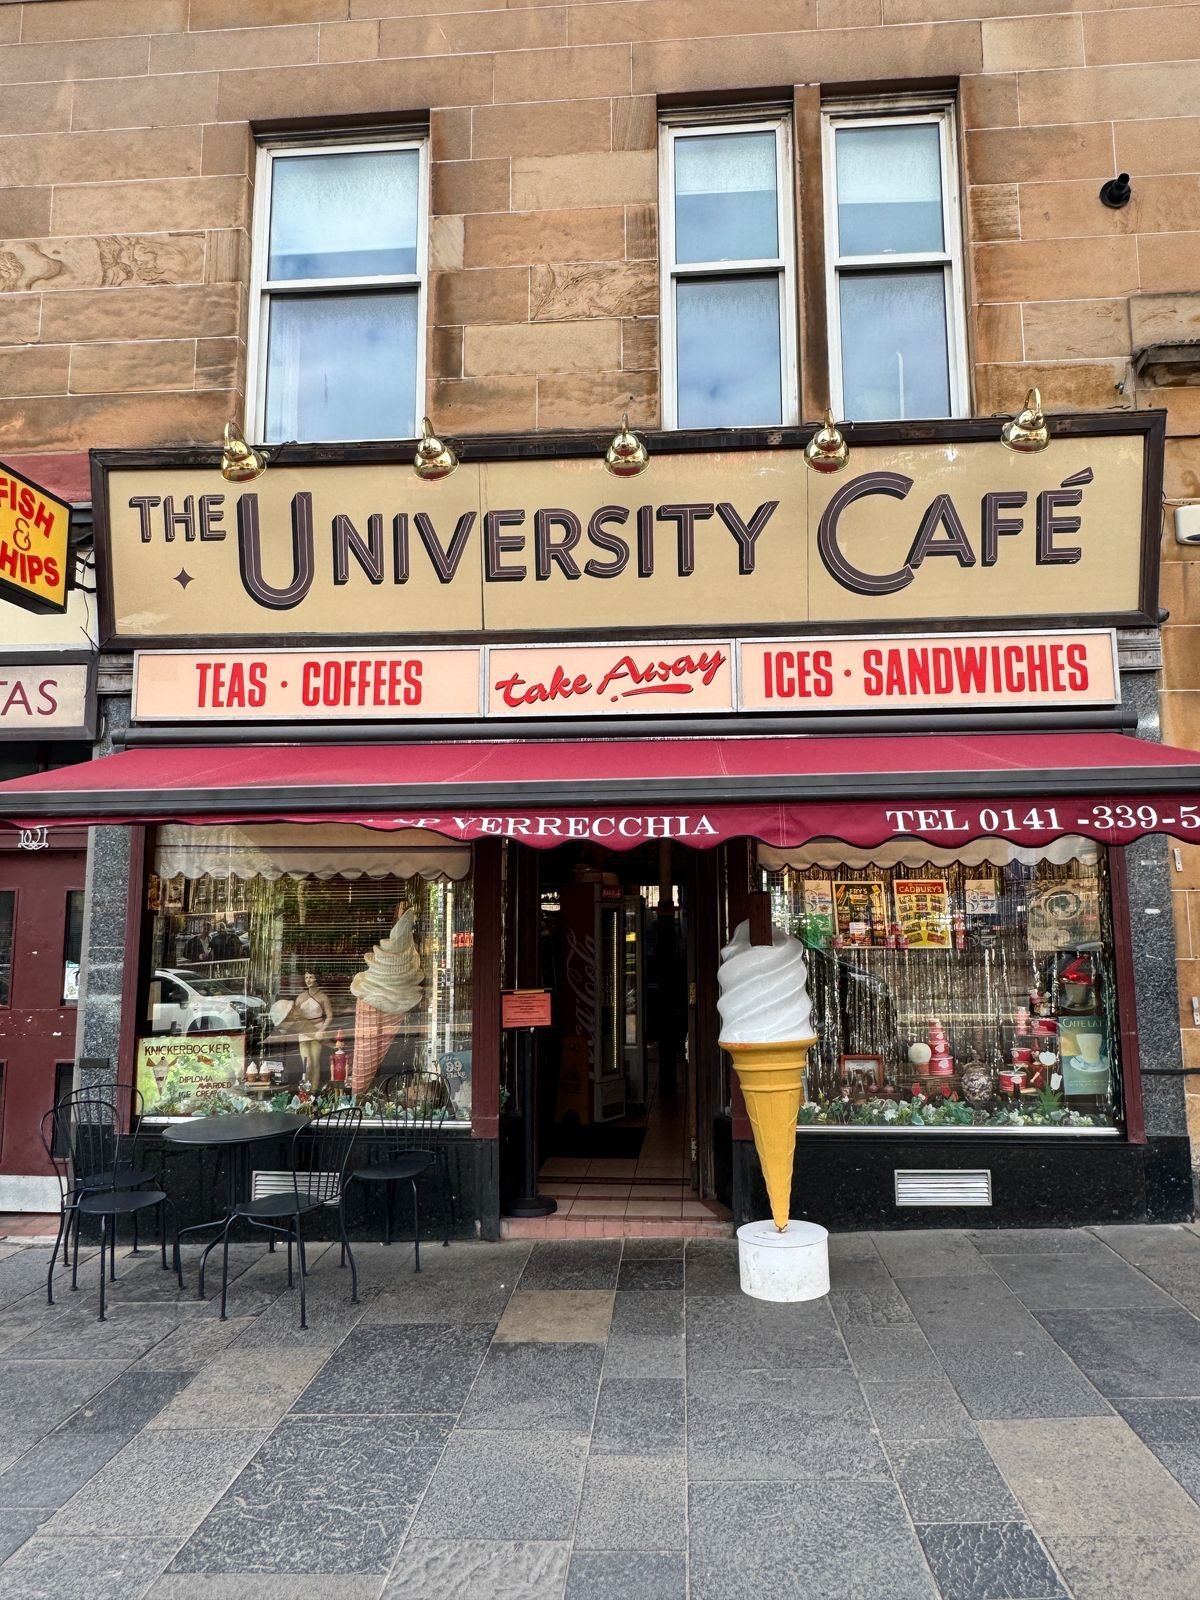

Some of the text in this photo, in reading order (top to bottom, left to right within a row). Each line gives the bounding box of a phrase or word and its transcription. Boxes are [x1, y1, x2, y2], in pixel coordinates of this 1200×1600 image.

[13, 517, 31, 551] &
[129, 466, 1094, 610] THE UNIVERSITY CAFÉ
[195, 659, 423, 708] TEAS COFFEES
[763, 643, 1089, 698] ICES SANDWICHES
[0, 679, 58, 716] AS
[451, 814, 719, 837] VERRECCHIA
[886, 808, 968, 833] TEL
[979, 806, 1064, 832] 0141
[145, 1043, 231, 1056] KNICKERBOCKER
[178, 1075, 214, 1084] DIPLOMA
[196, 1081, 232, 1090] AWARDED
